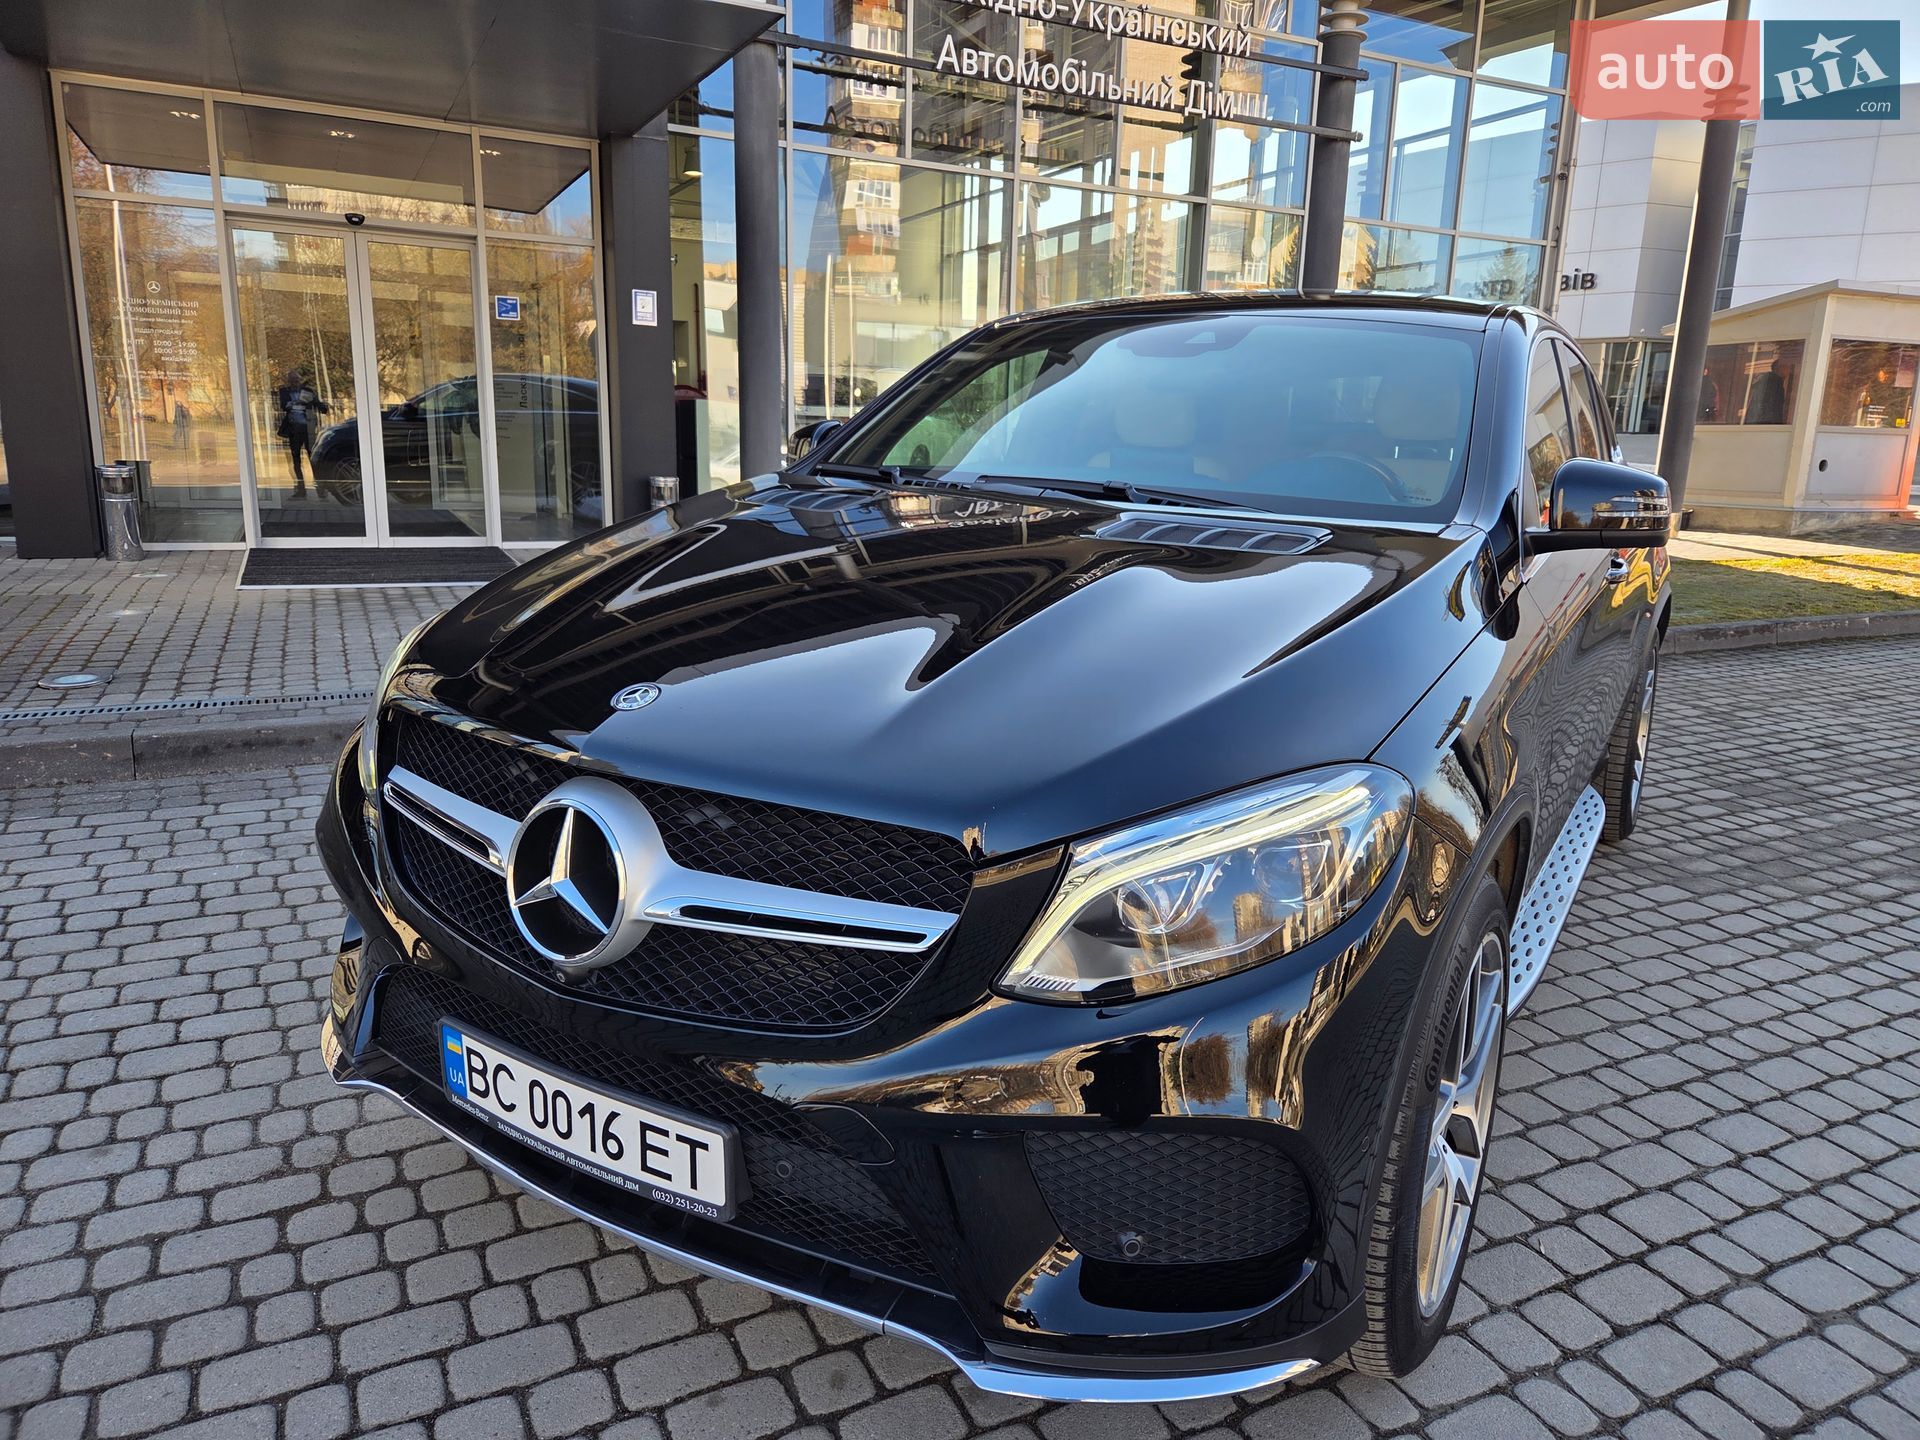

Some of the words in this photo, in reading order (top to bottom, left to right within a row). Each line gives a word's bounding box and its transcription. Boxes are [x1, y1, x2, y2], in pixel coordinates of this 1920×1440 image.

[936, 34, 1175, 110] Автомобільний
[1184, 80, 1235, 119] Дім
[1424, 955, 1465, 1093] Continental
[449, 1066, 465, 1088] UA
[465, 1046, 517, 1113] BC
[529, 1079, 625, 1162] 0016
[639, 1120, 709, 1191] ET
[652, 1188, 674, 1205] (032)
[676, 1197, 718, 1218] 251-20-23
